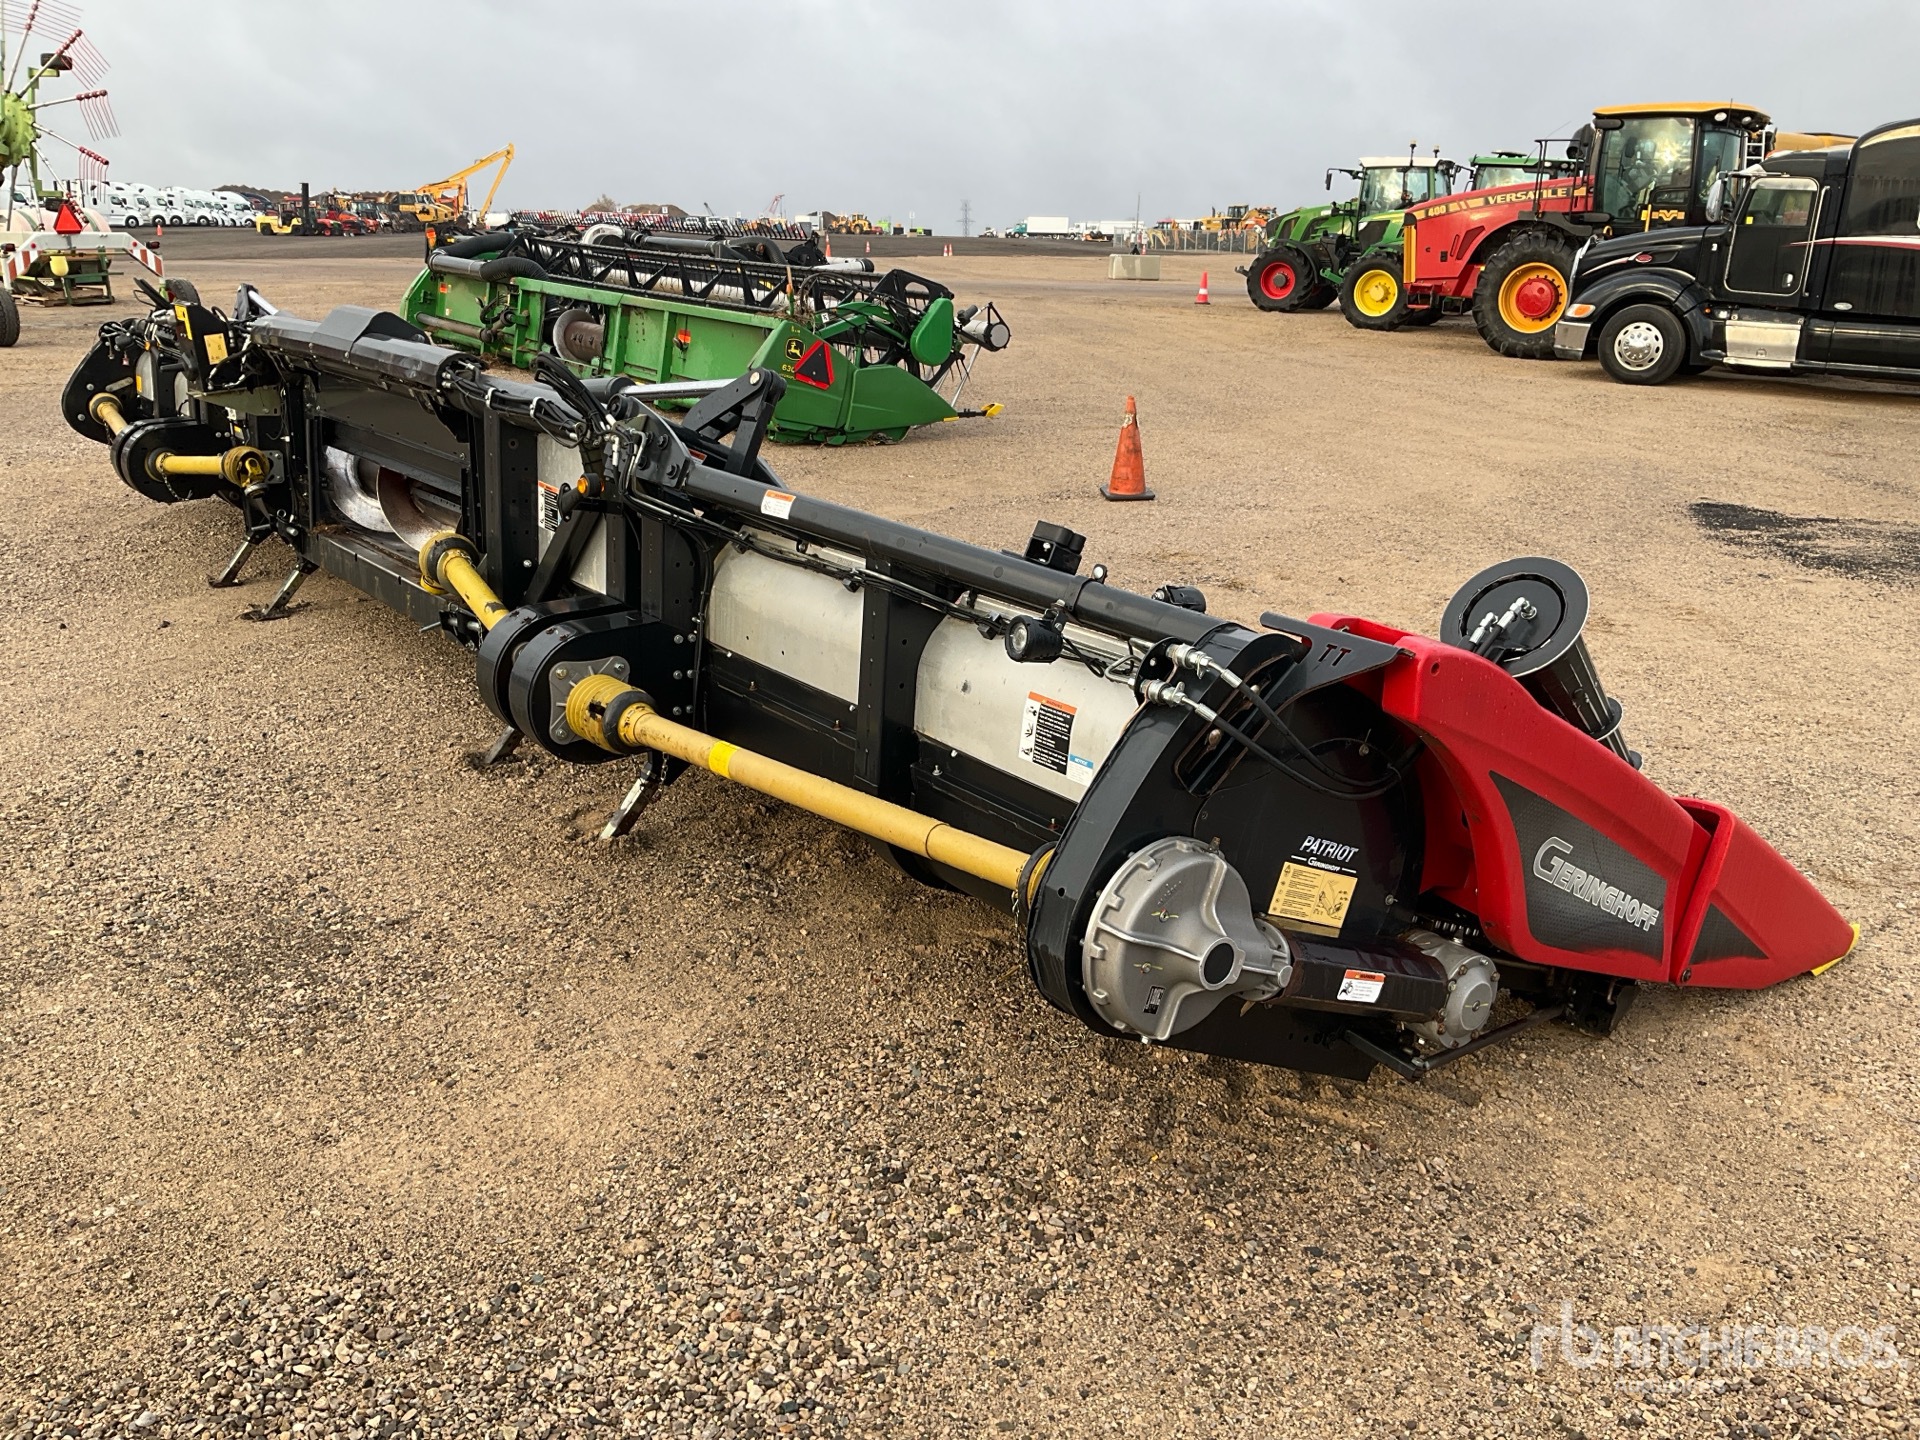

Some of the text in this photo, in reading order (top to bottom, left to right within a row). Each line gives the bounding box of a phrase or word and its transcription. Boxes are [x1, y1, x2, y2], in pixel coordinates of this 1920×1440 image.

[1488, 188, 1568, 204] VERSATILE
[1300, 835, 1359, 862] PATRIOT
[1533, 836, 1660, 932] GERINGHOFF
